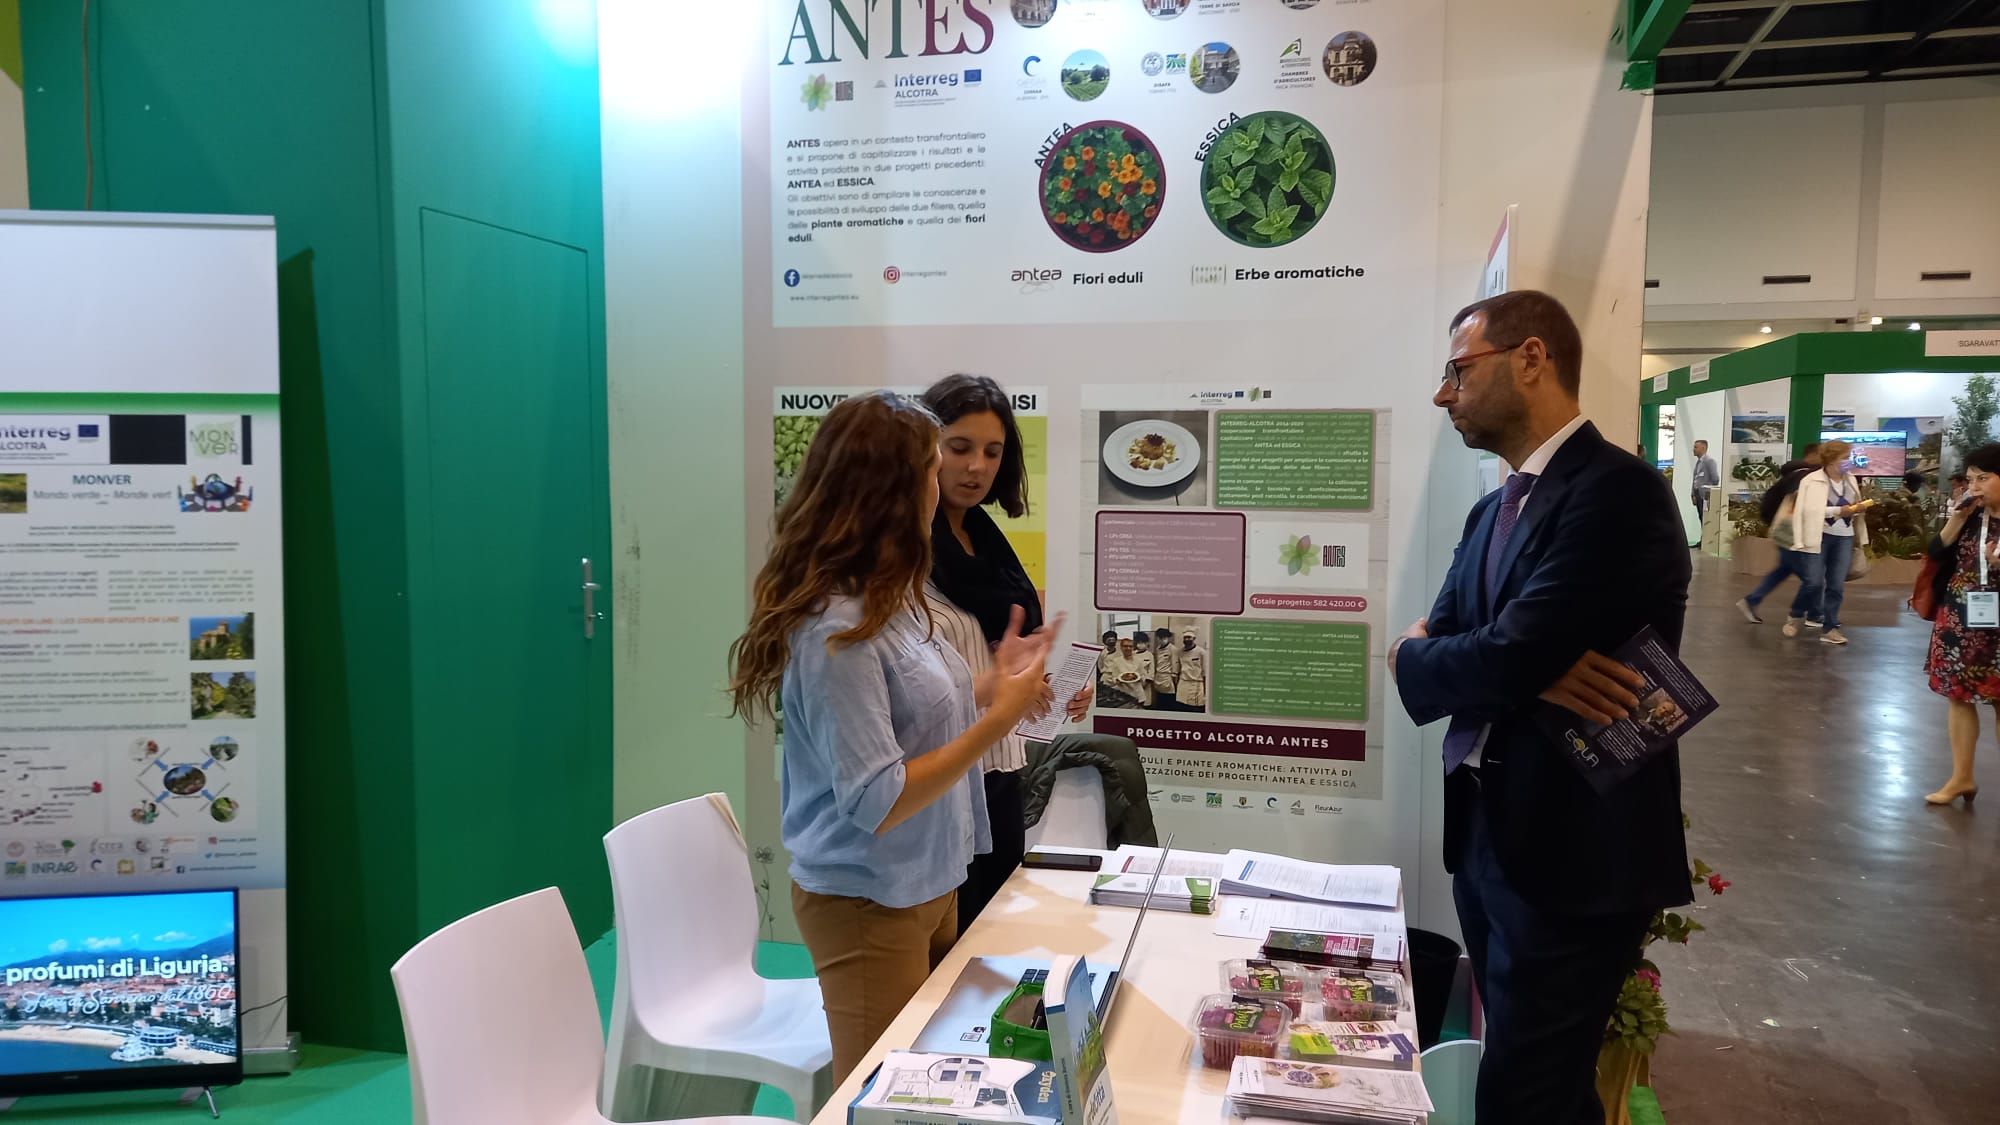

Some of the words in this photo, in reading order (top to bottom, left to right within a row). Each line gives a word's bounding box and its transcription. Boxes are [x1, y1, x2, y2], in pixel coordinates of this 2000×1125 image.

[777, 0, 994, 66] ANTES
[894, 73, 958, 87] Interreg
[895, 88, 939, 98] ALCOTRA
[787, 139, 820, 148] ANTES
[823, 140, 849, 148] opera
[875, 136, 914, 145] contesto
[917, 132, 986, 142] transfrontaliero
[1034, 121, 1075, 169] ANTEA
[1194, 112, 1242, 163] ESSICA
[808, 153, 844, 163] propone
[848, 152, 856, 160] di
[861, 149, 917, 160] capitalizzare
[928, 146, 962, 155] risultati
[821, 166, 860, 175] prodotte
[874, 164, 892, 172] due
[895, 162, 931, 172] progetti
[788, 179, 821, 188] ANTEA
[872, 191, 911, 200] ampliare
[923, 188, 977, 197] conoscenze
[851, 204, 887, 214] sviluppo
[958, 201, 986, 211] quella
[812, 219, 843, 230] piante
[847, 216, 904, 227] aromatiche
[916, 216, 944, 226] quella
[965, 213, 985, 224] fiori
[1011, 267, 1062, 282] antea
[1073, 273, 1104, 285] Fiori
[1108, 271, 1143, 284] eduli
[1235, 268, 1270, 280] Erbe
[1274, 265, 1365, 280] aromatiche
[781, 394, 848, 410] NUOV
[1012, 394, 1036, 410] ISI
[0, 425, 71, 441] nterreg
[190, 429, 235, 442] MON
[0, 442, 47, 451] LCOTRA
[72, 474, 132, 485] MONVER
[33, 490, 69, 500] Mondo
[71, 490, 100, 500] verde
[113, 489, 149, 499] Monde
[151, 490, 172, 499] vert
[1252, 597, 1276, 605] Totale
[1277, 598, 1313, 607] progetto:
[1127, 727, 1202, 741] PROGETTO
[1207, 732, 1275, 746] ALCOTRA
[1280, 737, 1329, 748] ANTES
[1140, 757, 1164, 765] DULI
[1176, 759, 1213, 768] PIANTE
[1216, 761, 1286, 773] AROMATICHE:
[1289, 766, 1338, 777] ATTIVITÀ
[1341, 769, 1353, 777] DI
[1145, 767, 1196, 778] ZZAZIONE
[1198, 771, 1215, 779] DEI
[1218, 772, 1268, 783] PROGETTI
[1272, 776, 1306, 785] ANTEA
[1319, 779, 1358, 789] ESSICA
[6, 958, 105, 986] profumi
[110, 958, 133, 977] di
